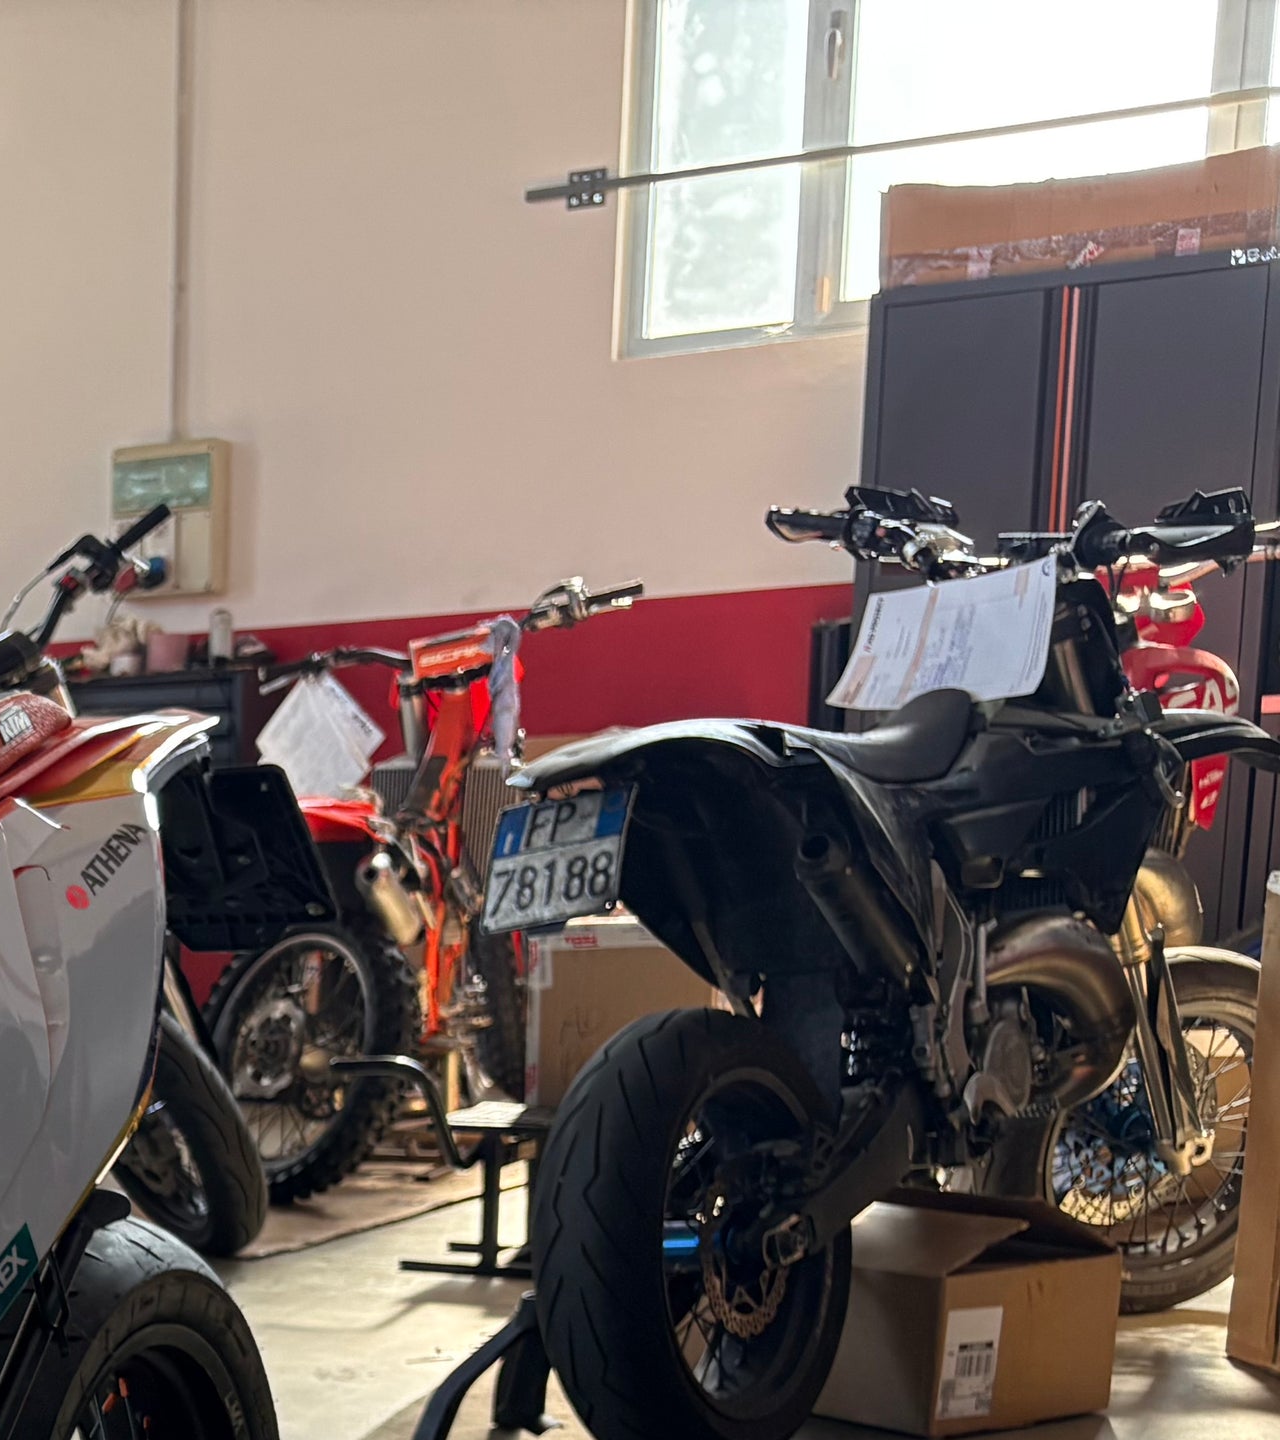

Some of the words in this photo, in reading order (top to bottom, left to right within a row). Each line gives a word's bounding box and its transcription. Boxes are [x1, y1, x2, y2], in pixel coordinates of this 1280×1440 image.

[526, 803, 577, 847] FP
[81, 824, 147, 896] ATHENA
[490, 851, 613, 917] 78188
